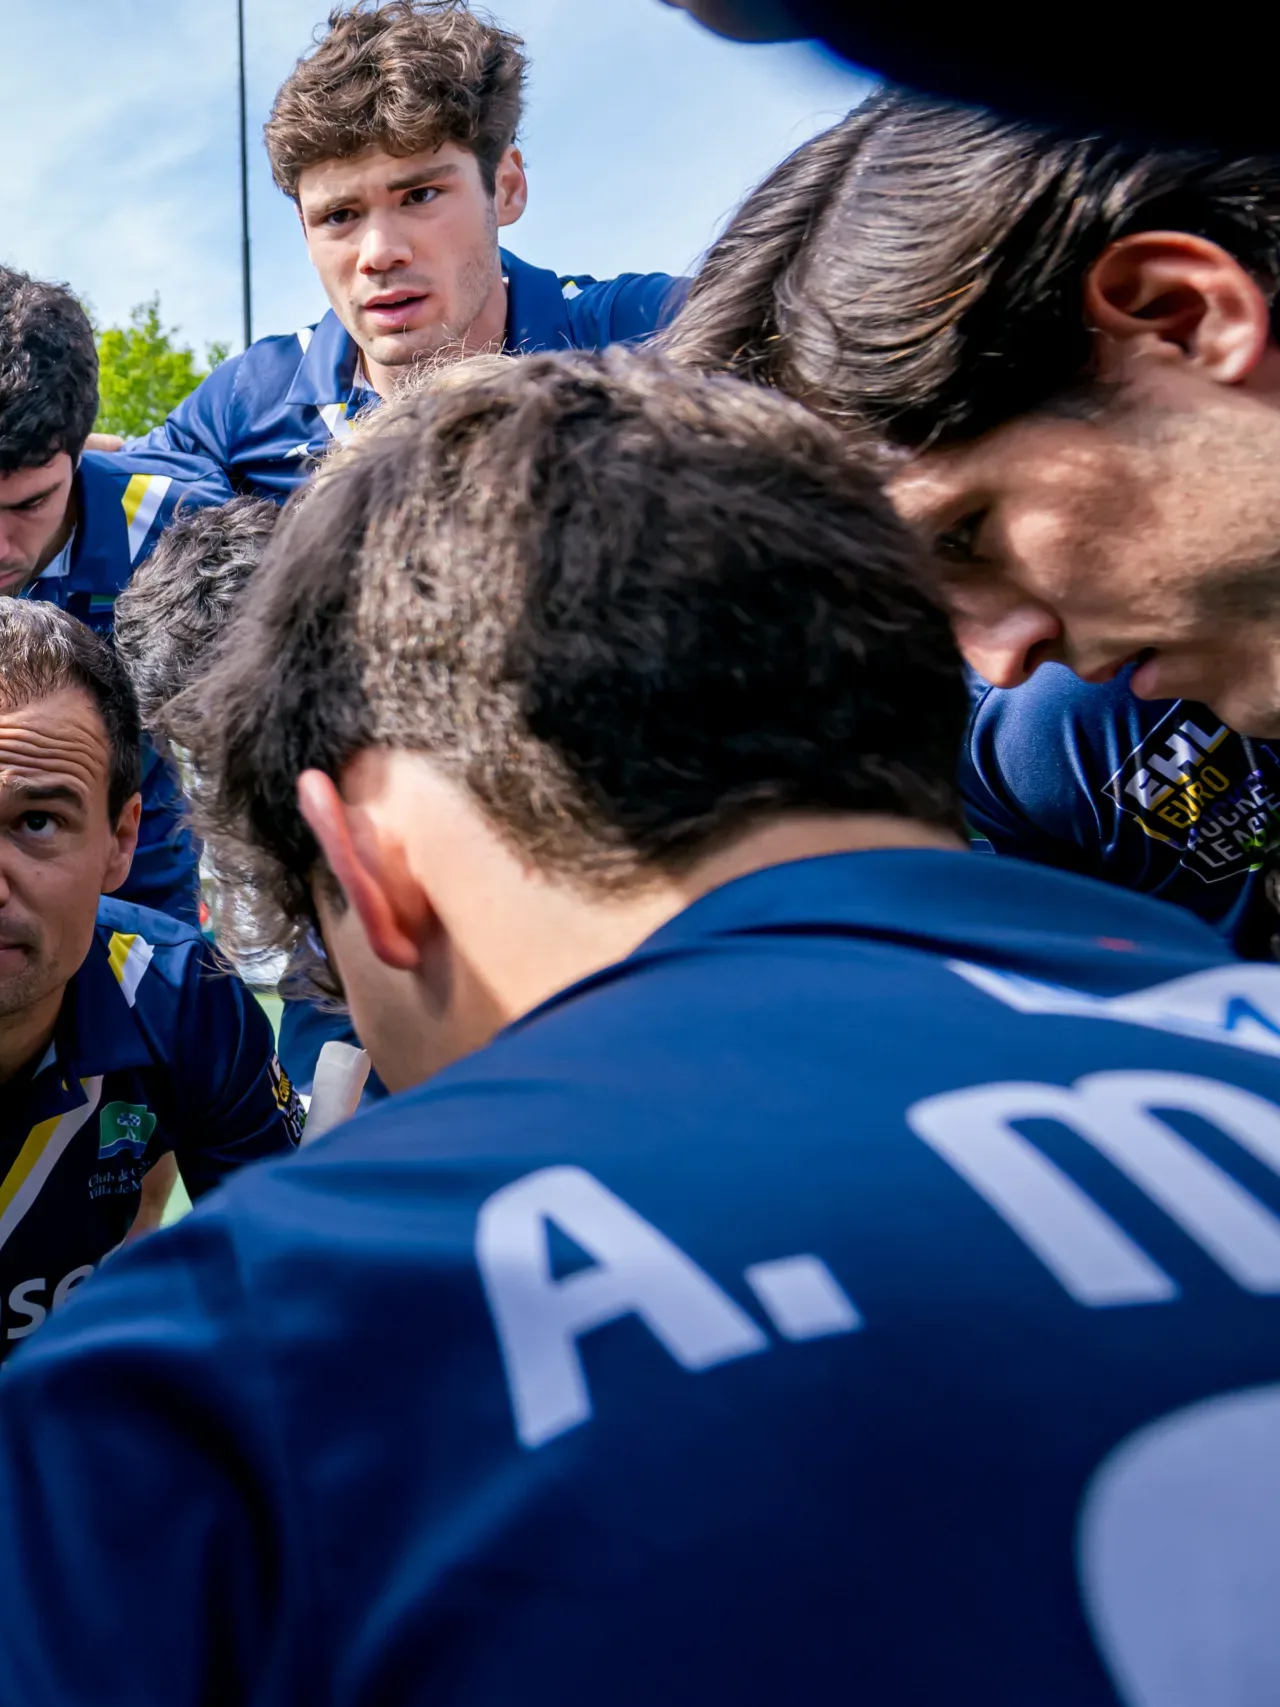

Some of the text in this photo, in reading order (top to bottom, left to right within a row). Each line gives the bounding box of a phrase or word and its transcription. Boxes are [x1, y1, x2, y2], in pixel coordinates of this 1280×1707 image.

[1124, 719, 1231, 811] EHL
[1157, 765, 1230, 829] EURO
[474, 1165, 866, 1451] A.
